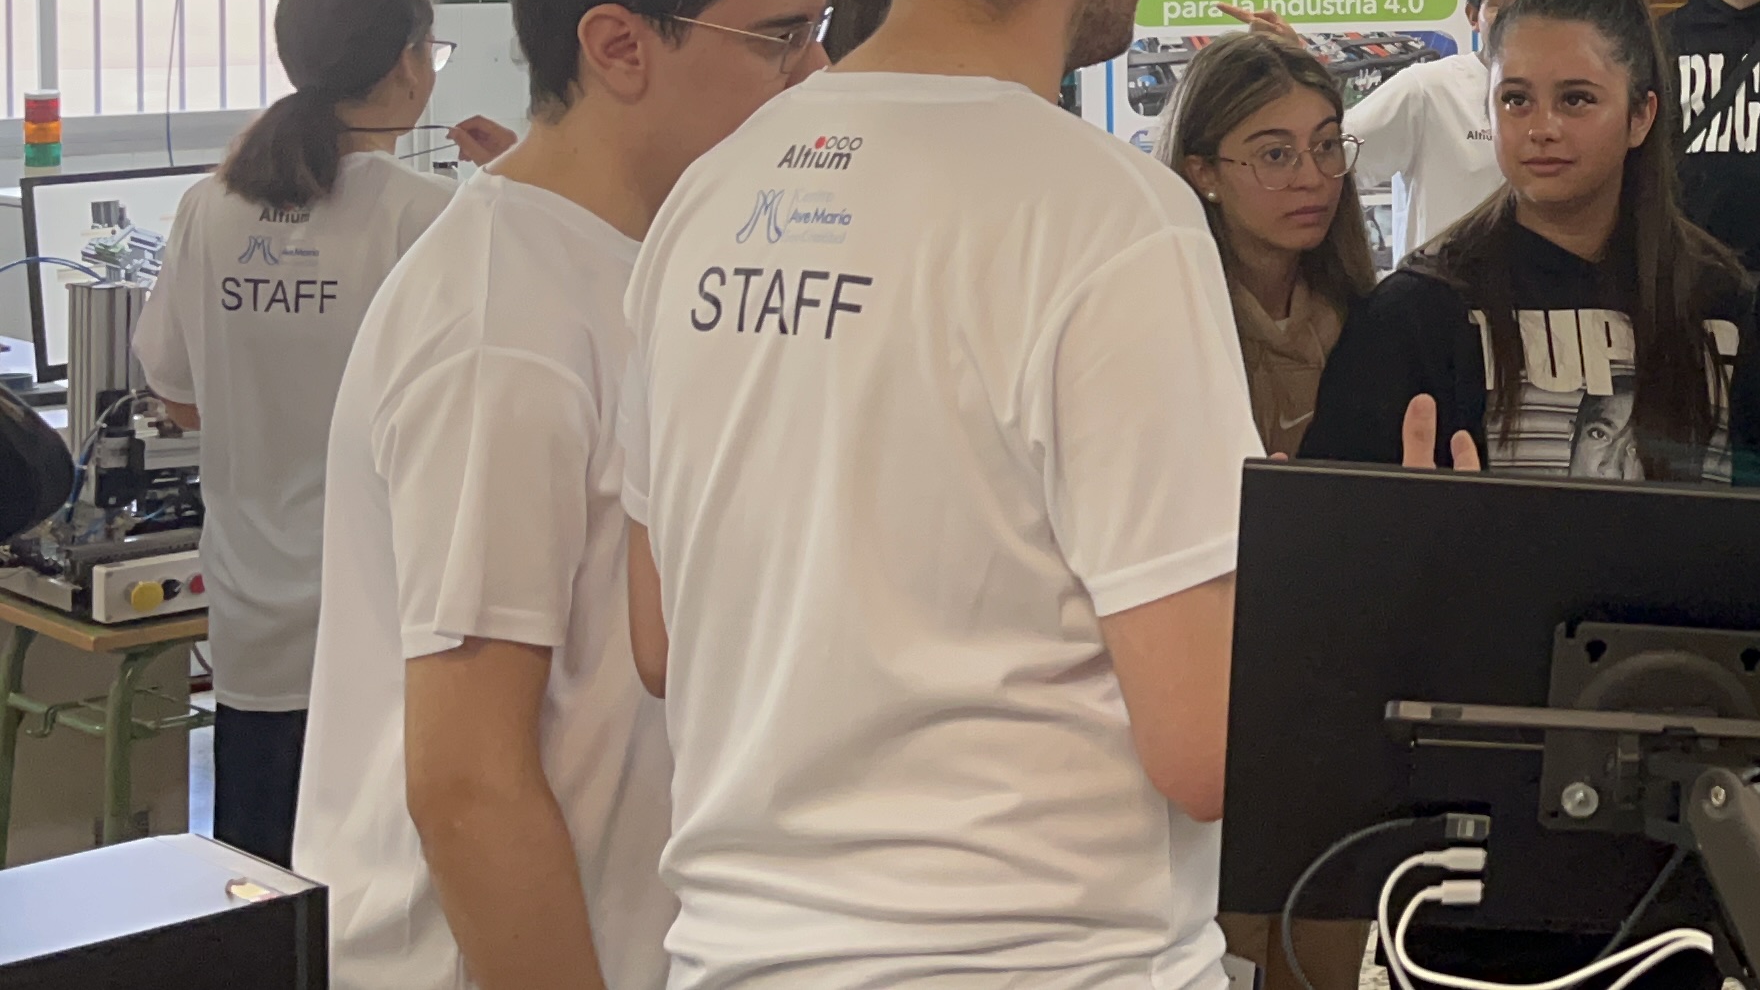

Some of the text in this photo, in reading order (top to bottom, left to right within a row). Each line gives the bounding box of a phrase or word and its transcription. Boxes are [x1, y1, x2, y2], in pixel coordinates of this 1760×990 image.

[1163, 0, 1223, 26] para
[1466, 130, 1492, 141] Altiu
[777, 144, 852, 171] Altium
[221, 276, 338, 314] STAFF
[691, 266, 873, 340] STAFF
